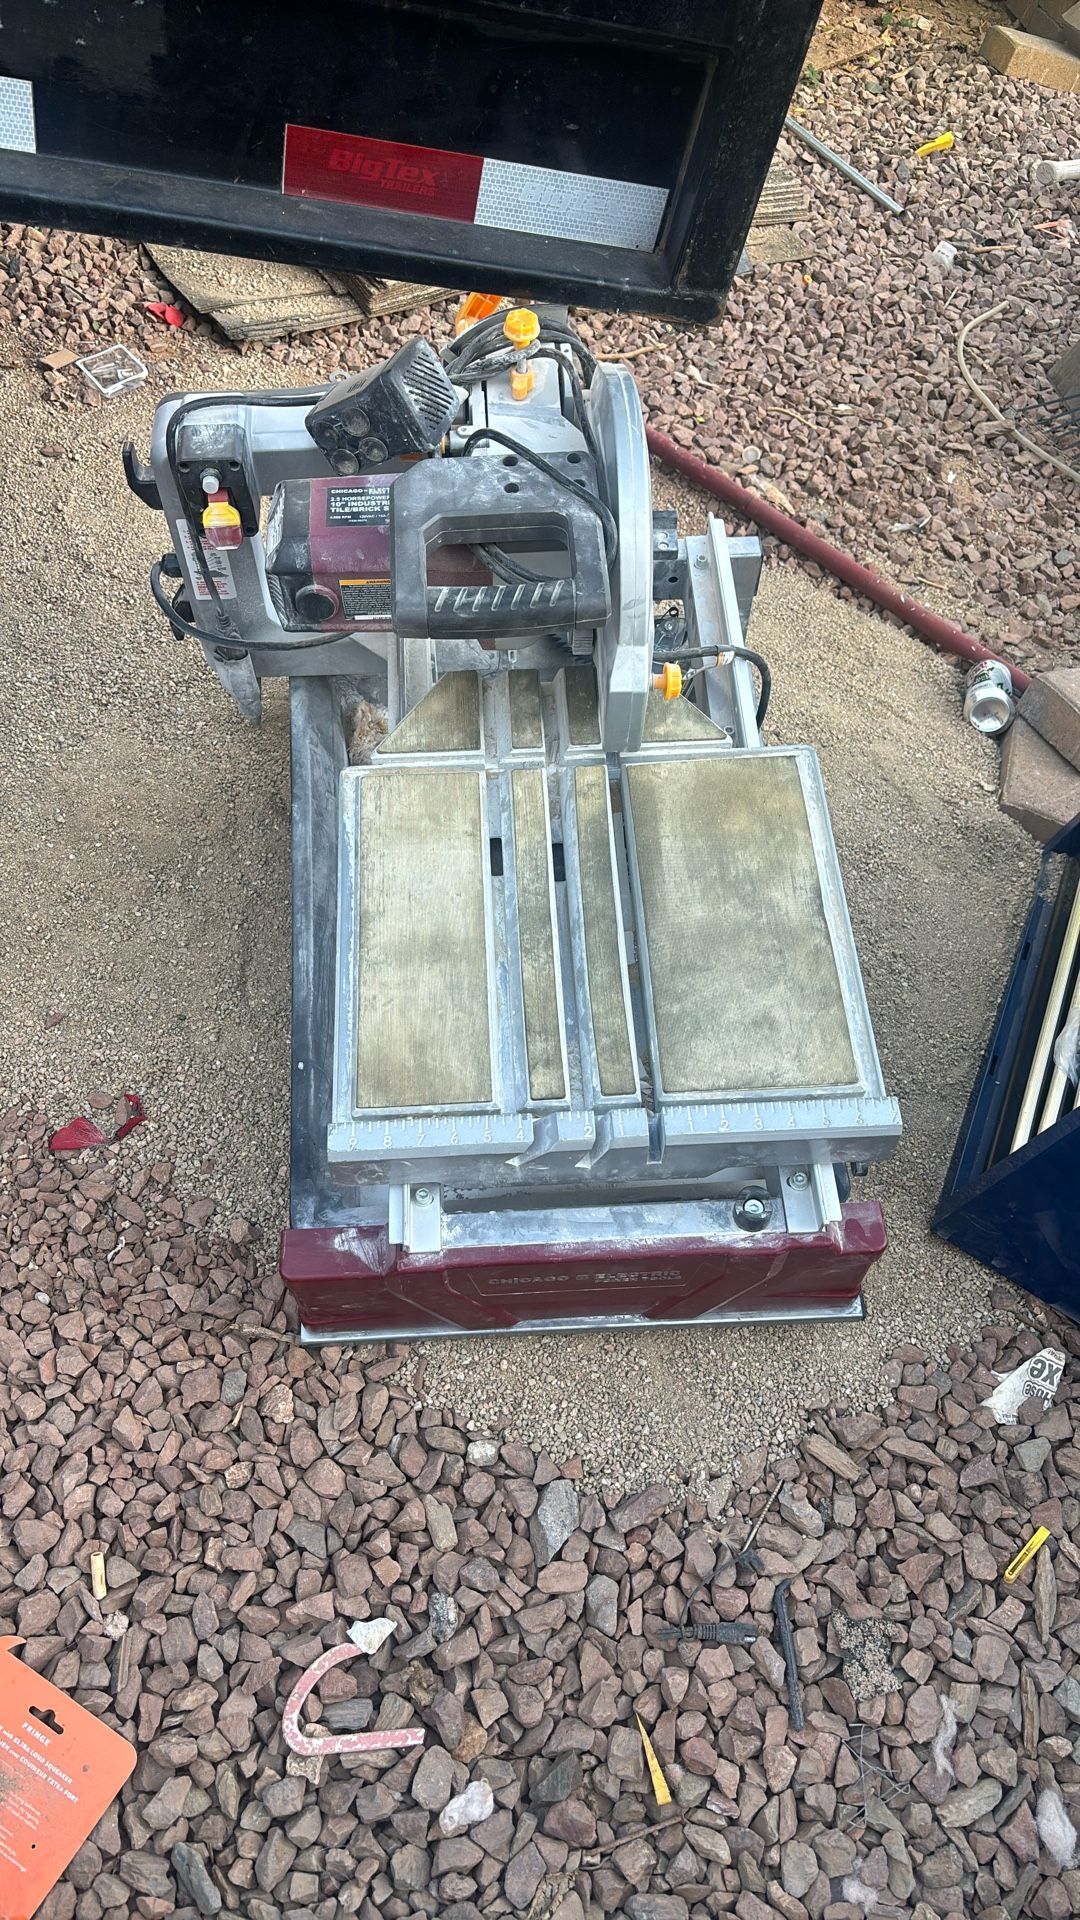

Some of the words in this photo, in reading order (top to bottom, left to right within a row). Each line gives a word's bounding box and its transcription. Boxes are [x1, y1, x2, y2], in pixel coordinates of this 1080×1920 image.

[328, 148, 440, 186] BigTex
[380, 179, 437, 196] TRAILERS
[347, 1137, 358, 1152] 9
[383, 1136, 392, 1148] 8
[416, 1133, 425, 1146] 7
[450, 1132, 459, 1144] 6
[483, 1129, 492, 1142] 5
[515, 1128, 525, 1141] 4
[583, 1125, 593, 1139] 2
[719, 1118, 729, 1132] 2
[754, 1117, 764, 1130] 3
[787, 1116, 795, 1128] 4
[822, 1114, 831, 1126] 5
[855, 1112, 864, 1124] 6
[488, 1275, 569, 1286] CHICAGO
[22, 1722, 52, 1747] FRINGE
[13, 1736, 30, 1754] EXTRA
[30, 1750, 45, 1764] LOUD
[44, 1760, 73, 1785] SQUEAKER
[19, 1757, 48, 1781] COUINEUR
[47, 1775, 64, 1793] EXTRA
[63, 1789, 80, 1804] FORT
